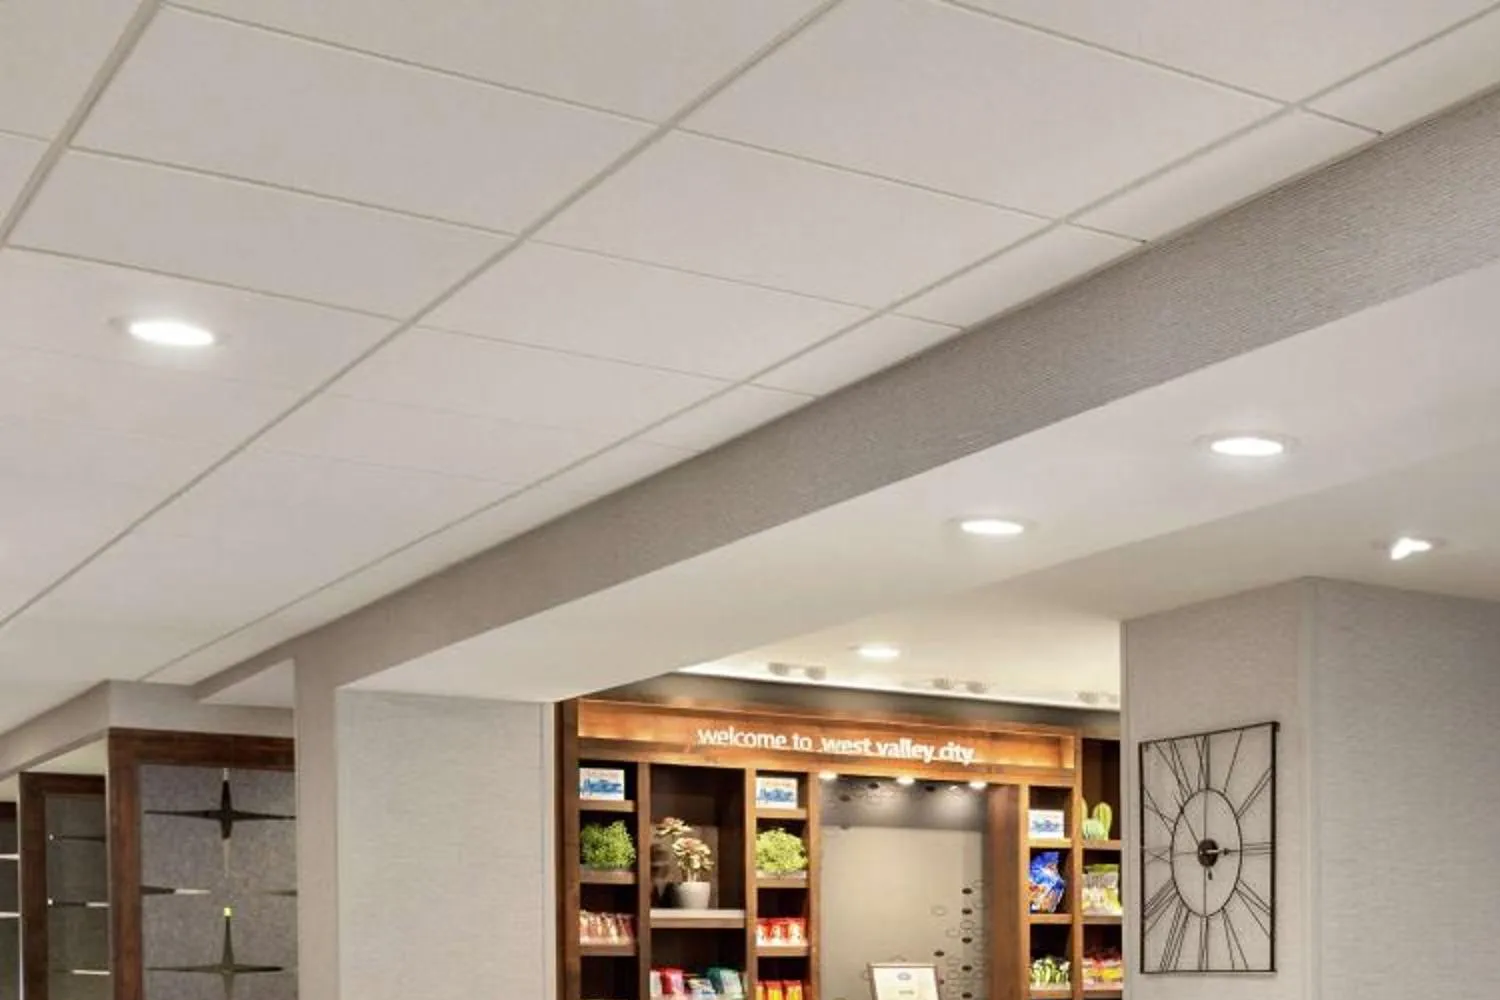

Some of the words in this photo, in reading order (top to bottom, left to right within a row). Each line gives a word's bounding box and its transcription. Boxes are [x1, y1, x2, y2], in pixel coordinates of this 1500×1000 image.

[697, 726, 787, 750] welcome
[792, 732, 812, 751] to
[821, 736, 872, 755] west
[877, 738, 934, 764] valley
[938, 741, 977, 765] city
